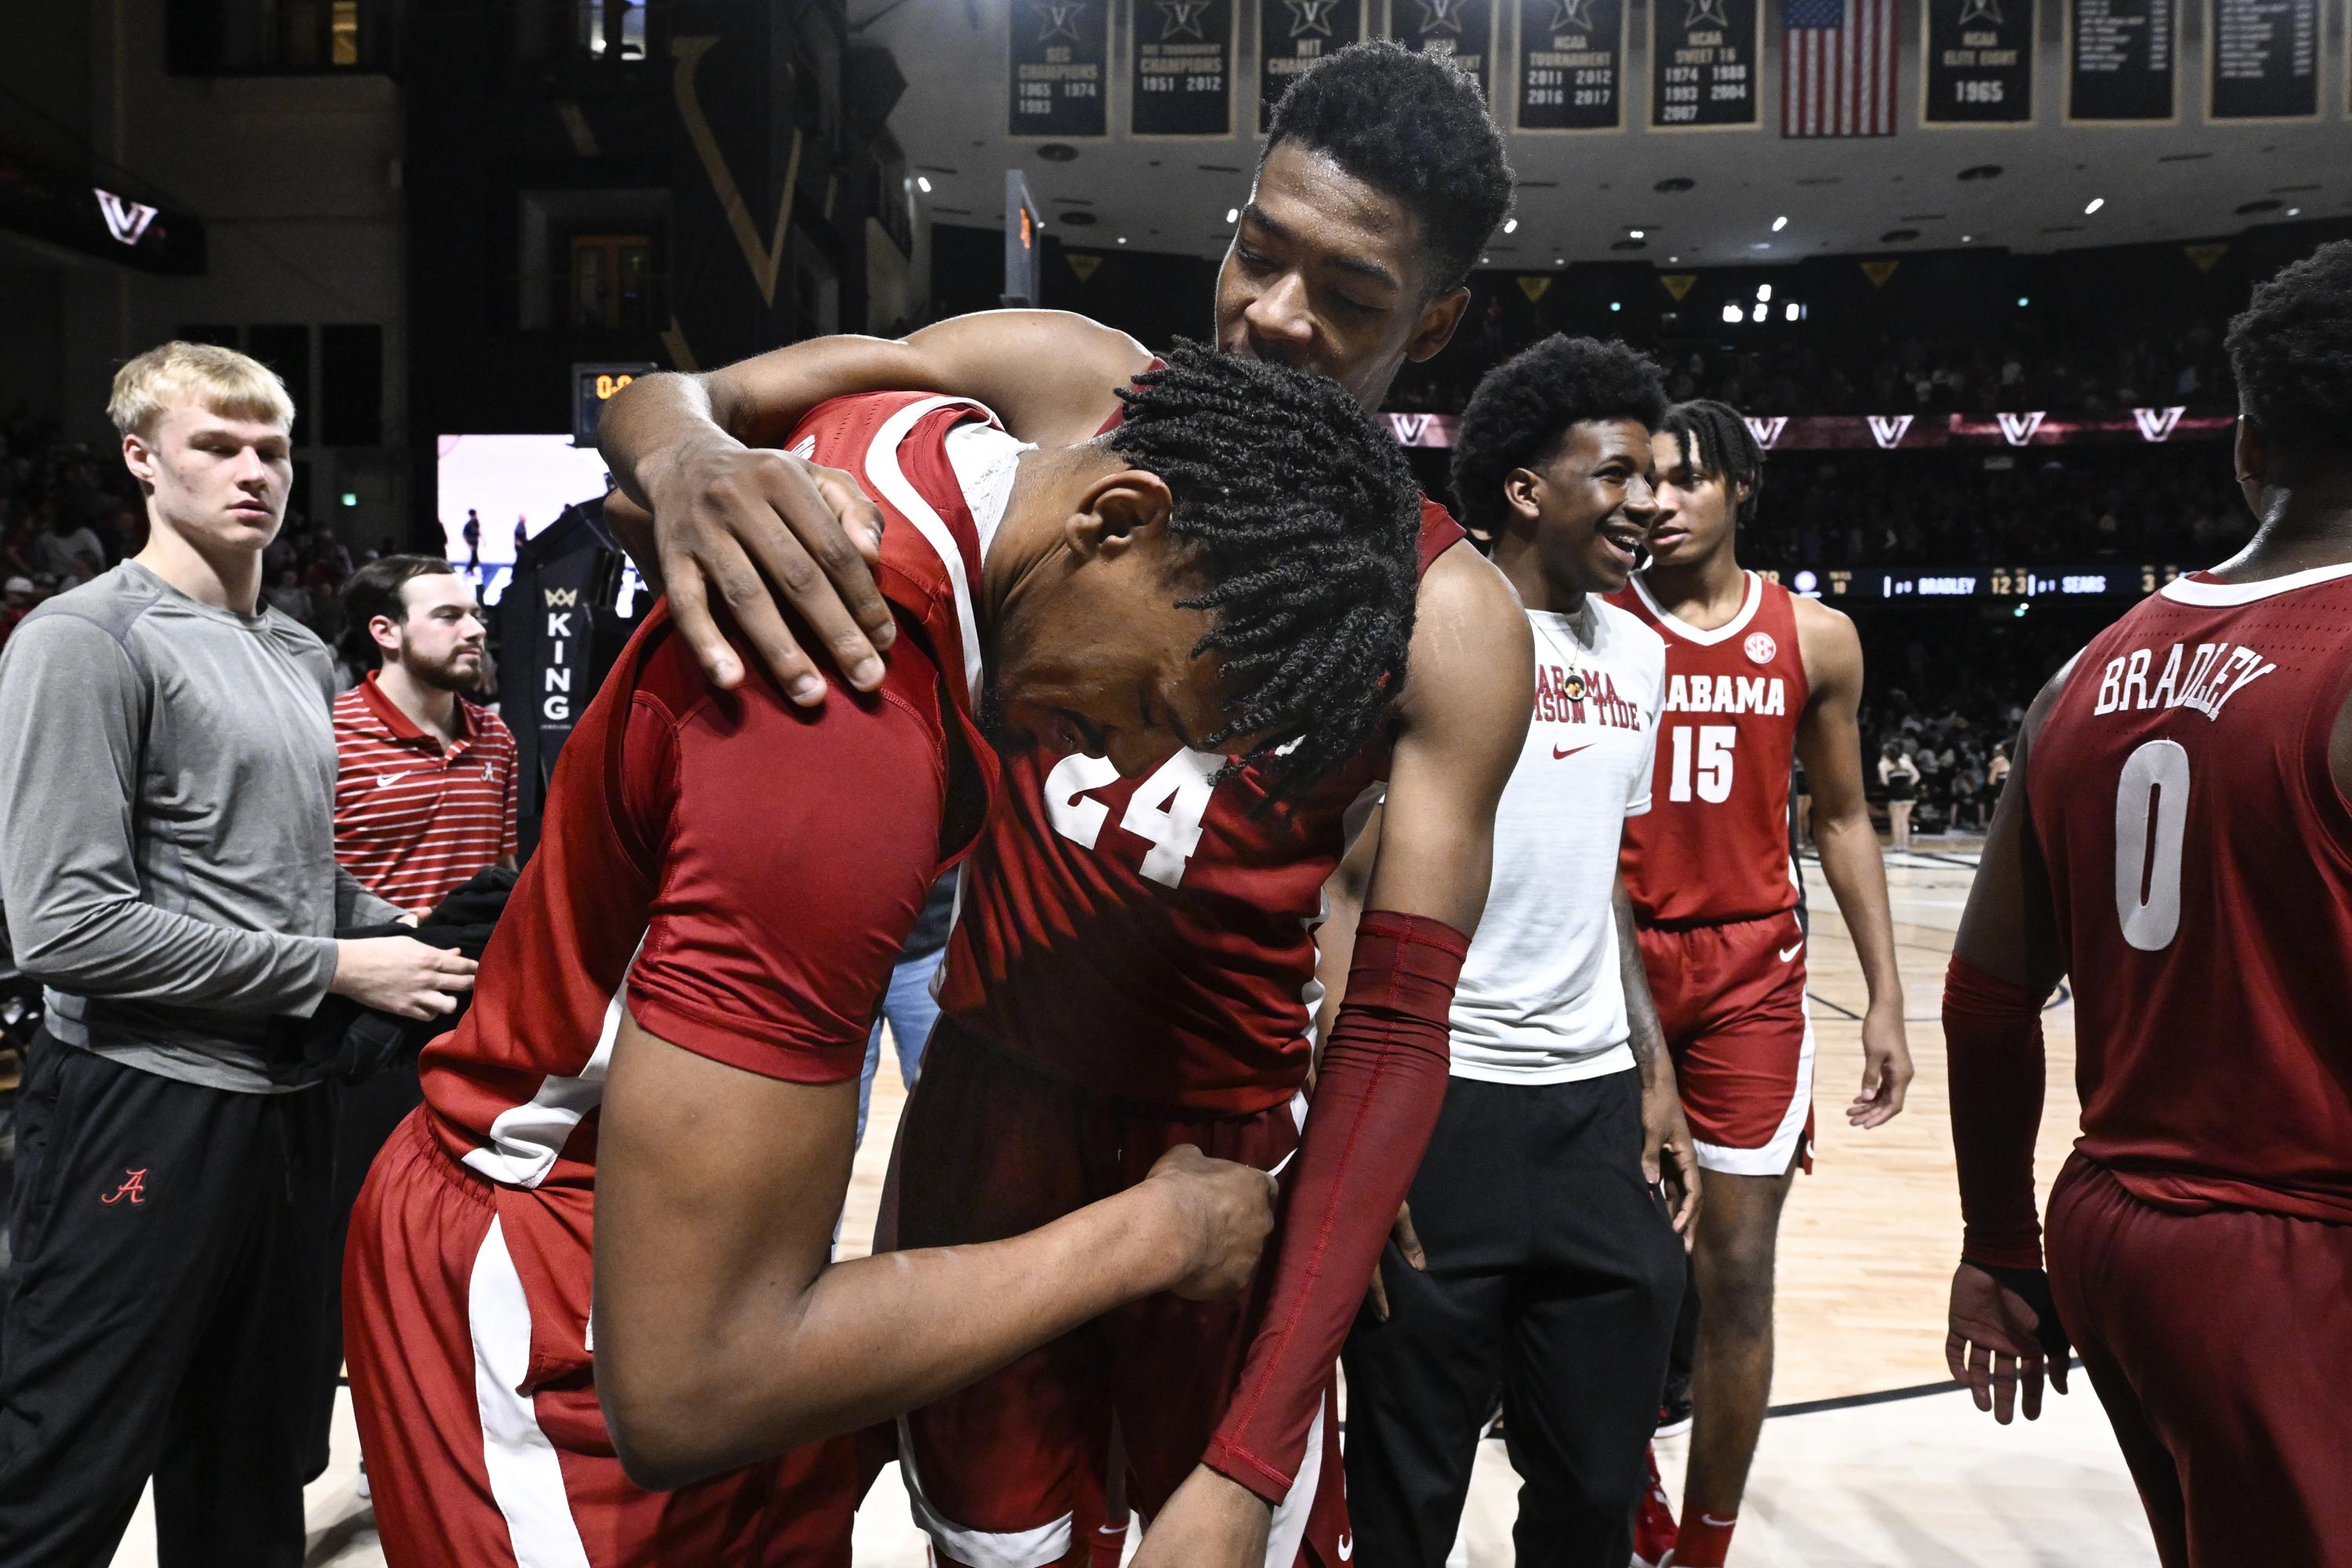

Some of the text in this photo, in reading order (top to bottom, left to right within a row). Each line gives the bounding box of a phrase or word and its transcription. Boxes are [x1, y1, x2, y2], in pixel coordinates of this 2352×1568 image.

[1719, 47, 1737, 63] 16
[1142, 76, 1222, 92] 1951 2012
[1528, 68, 1612, 86] 2011 2012
[1665, 66, 1699, 83] 1974
[1955, 79, 2005, 103] 1965
[1527, 89, 1611, 106] 2016 2017
[93, 187, 159, 246] V
[1389, 412, 1433, 447] V
[1744, 416, 1788, 450] V
[1866, 415, 1915, 449] V
[1996, 412, 2046, 446] V
[2132, 406, 2187, 442] V
[1918, 577, 1976, 595] BRADLEY
[1992, 576, 2012, 594] 12
[2062, 575, 2107, 593] SEARS
[543, 612, 572, 720] KING
[1537, 664, 1620, 703] ABMA
[2094, 643, 2277, 721] BRADLEY
[1664, 674, 1785, 716] ABAMA
[1593, 696, 1640, 731] TIDE
[1669, 725, 1737, 804] 15
[1044, 746, 1229, 889] 24
[2115, 739, 2190, 951] 0
[100, 1168, 148, 1204] A
